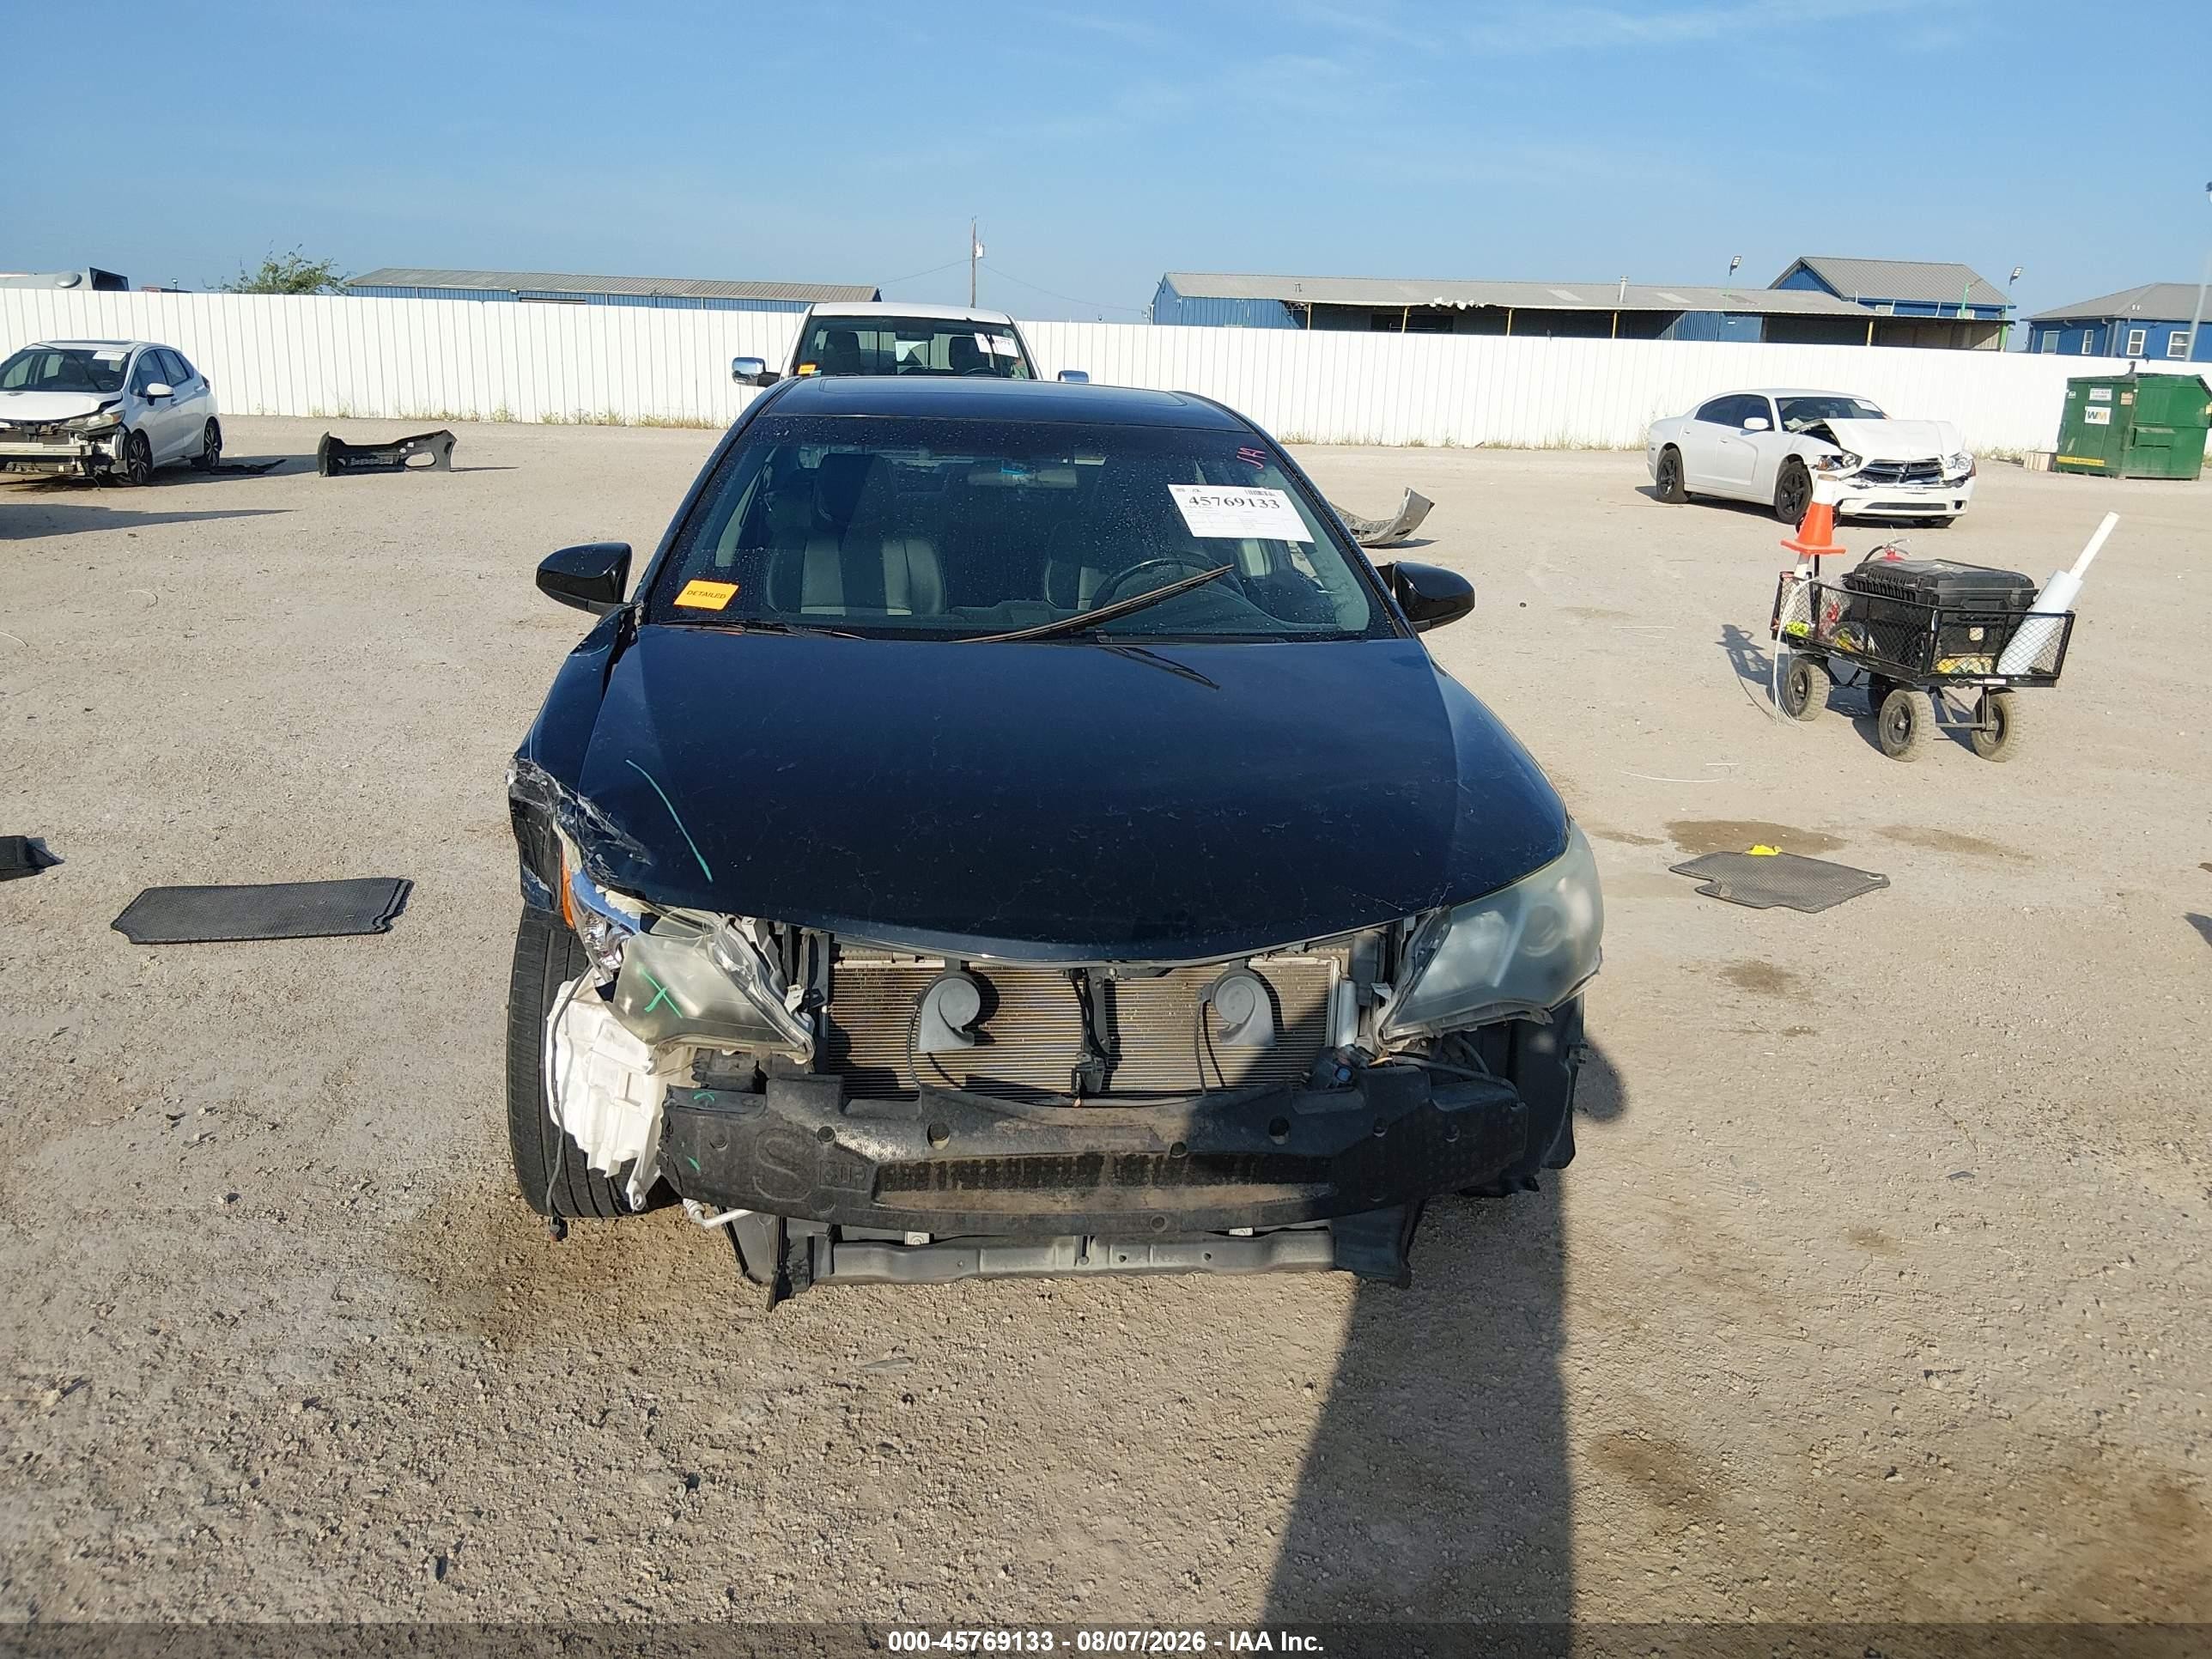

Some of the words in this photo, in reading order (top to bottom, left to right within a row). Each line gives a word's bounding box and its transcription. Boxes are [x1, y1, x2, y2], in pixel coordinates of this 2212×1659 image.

[2087, 411, 2107, 420] WM
[1188, 495, 1280, 509] 45769133
[686, 590, 727, 599] DETAILED
